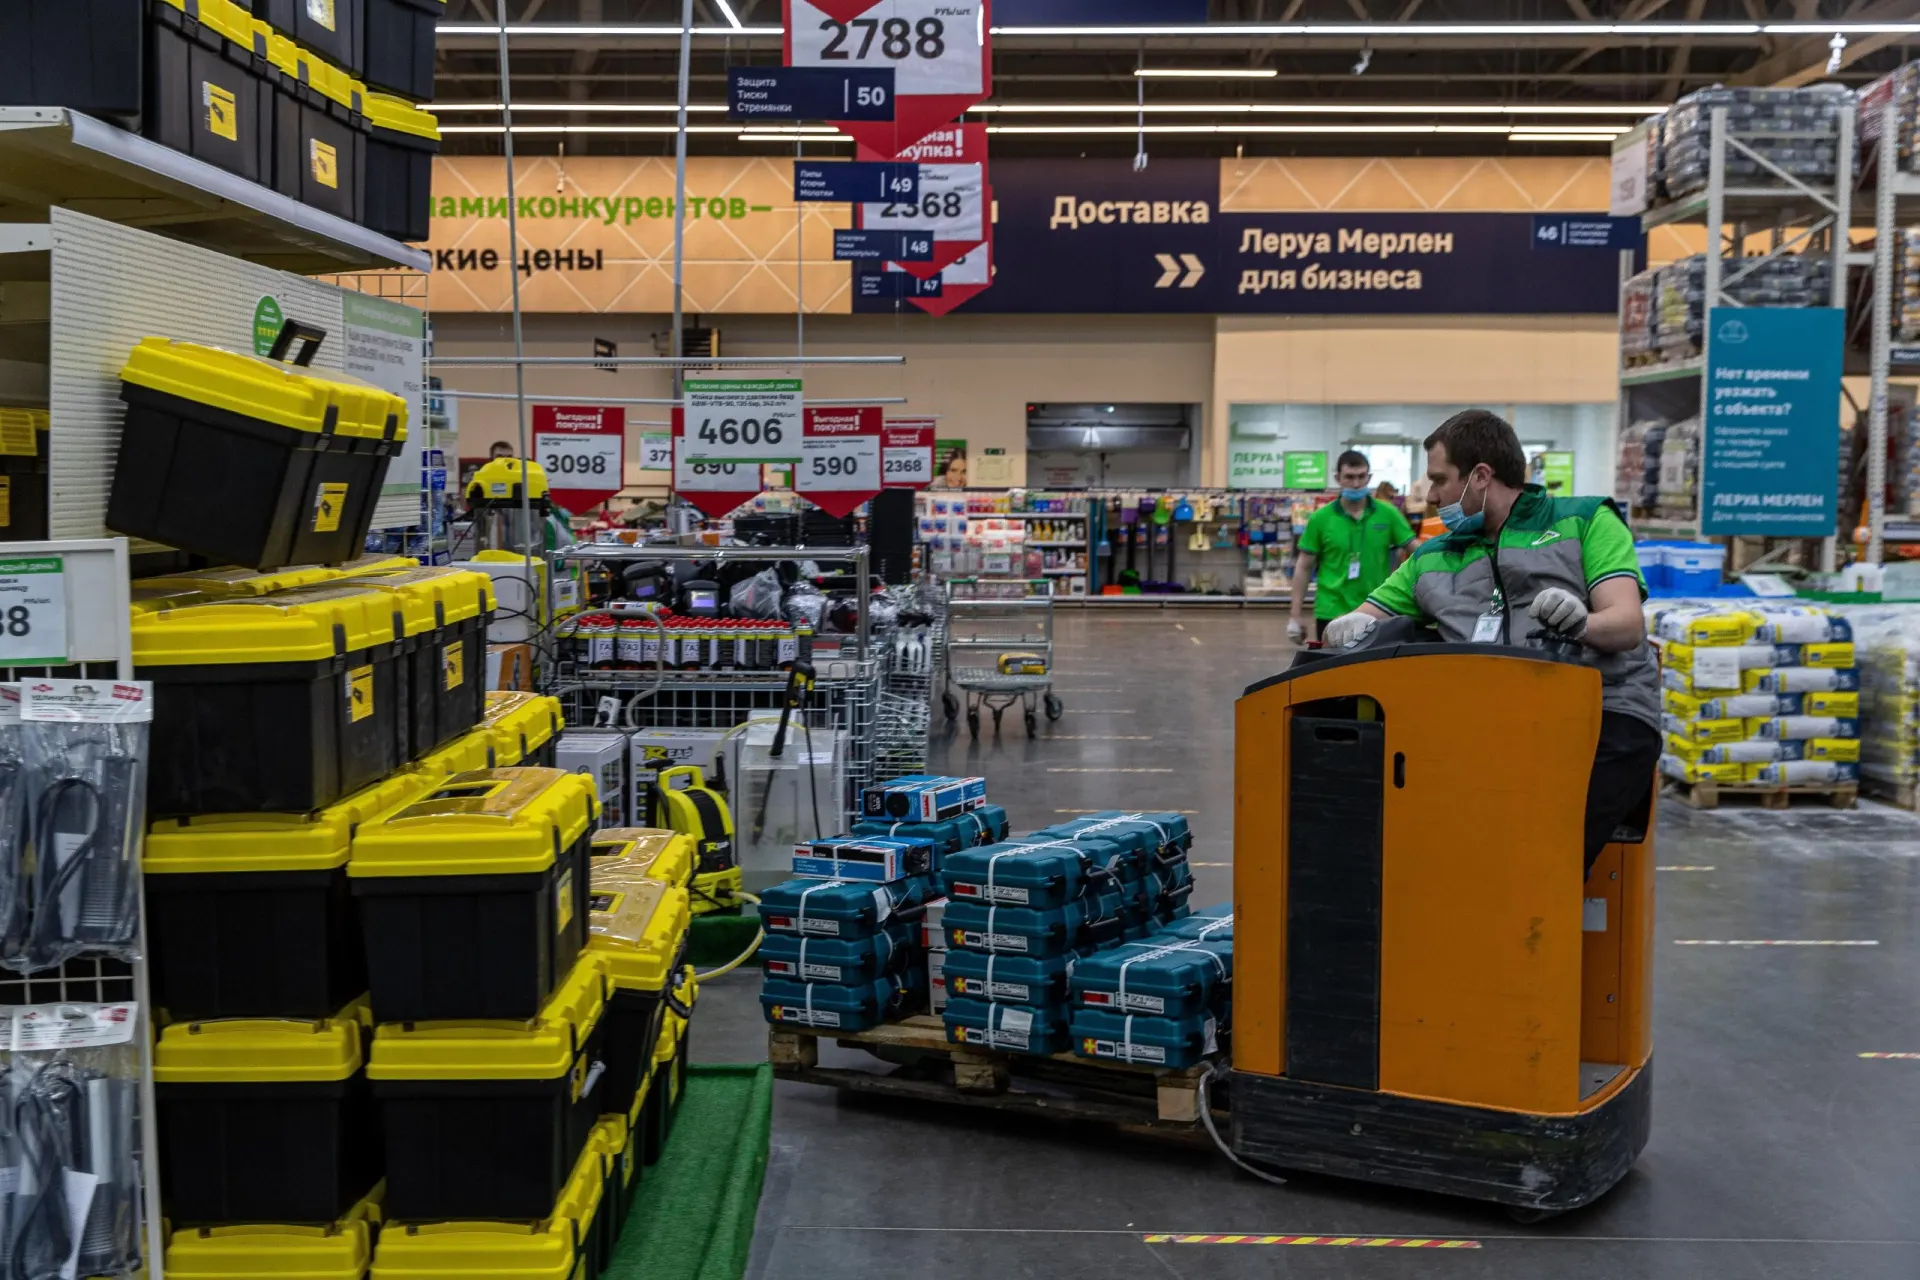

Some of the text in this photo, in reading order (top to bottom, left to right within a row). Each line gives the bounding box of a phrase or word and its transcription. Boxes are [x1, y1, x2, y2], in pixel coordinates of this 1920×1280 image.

[818, 17, 946, 60] 2788
[737, 77, 777, 88] Защита
[737, 89, 768, 99] Тиски
[856, 86, 885, 106] 50
[737, 102, 792, 113] Стремянки
[889, 178, 913, 193] 49
[1050, 195, 1210, 230] Доставка
[910, 240, 929, 253] 48
[1238, 227, 1454, 259] Леруа Мерлен
[516, 248, 603, 277] цены
[923, 279, 938, 291] 47
[1238, 263, 1422, 294] для бизнеса
[1715, 368, 1810, 382] Нет времени
[1713, 402, 1792, 416] с объекта?
[555, 412, 597, 422] Выгодная
[813, 415, 854, 424] Выгодная
[698, 417, 783, 445] 4606
[545, 454, 606, 474] 3098
[812, 456, 858, 476] 590
[885, 459, 922, 473] 2368
[1712, 493, 1824, 507] ЛЕРУА МЕРЛЕН
[0, 605, 31, 637] 8
